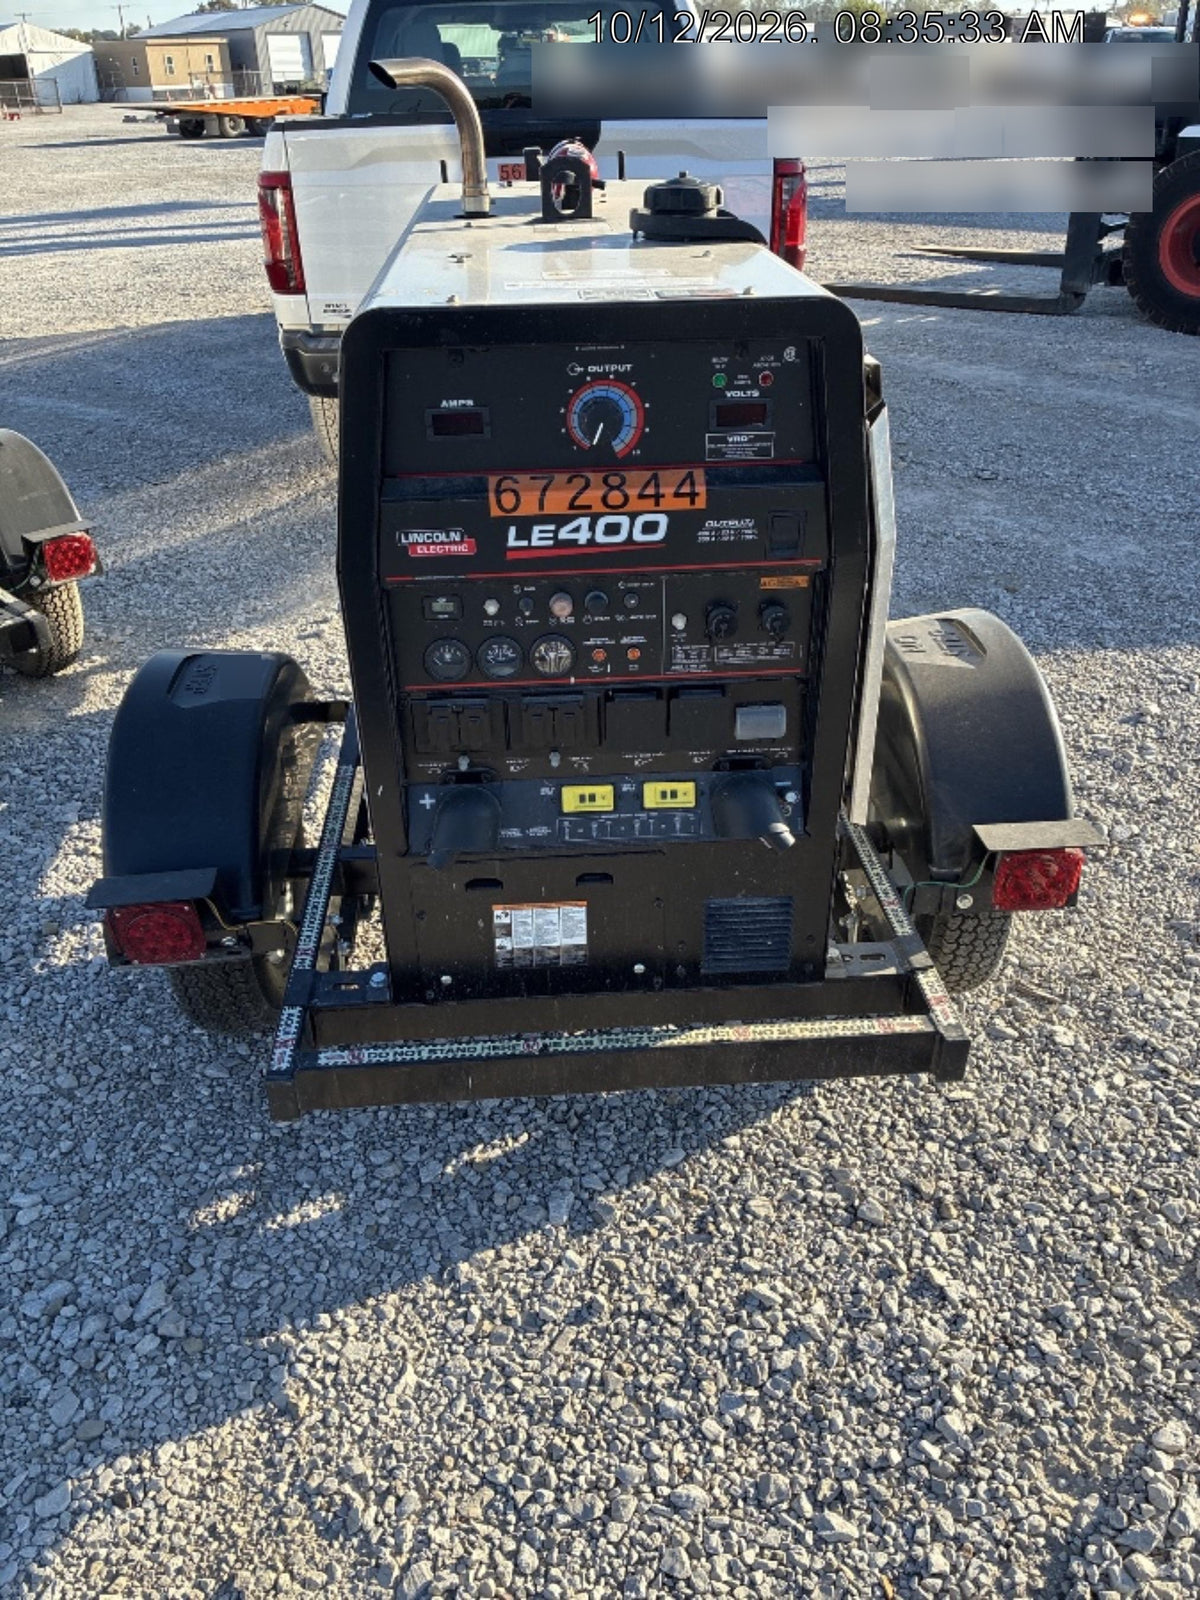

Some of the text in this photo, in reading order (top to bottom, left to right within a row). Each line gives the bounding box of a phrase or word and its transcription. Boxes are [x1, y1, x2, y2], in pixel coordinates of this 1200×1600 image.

[587, 364, 632, 372] OUTPUT
[725, 389, 760, 398] VOLTS
[493, 470, 700, 514] 672844
[506, 513, 669, 547] LE400
[399, 530, 462, 544] LINCOLN
[416, 544, 469, 554] ELECTRIC
